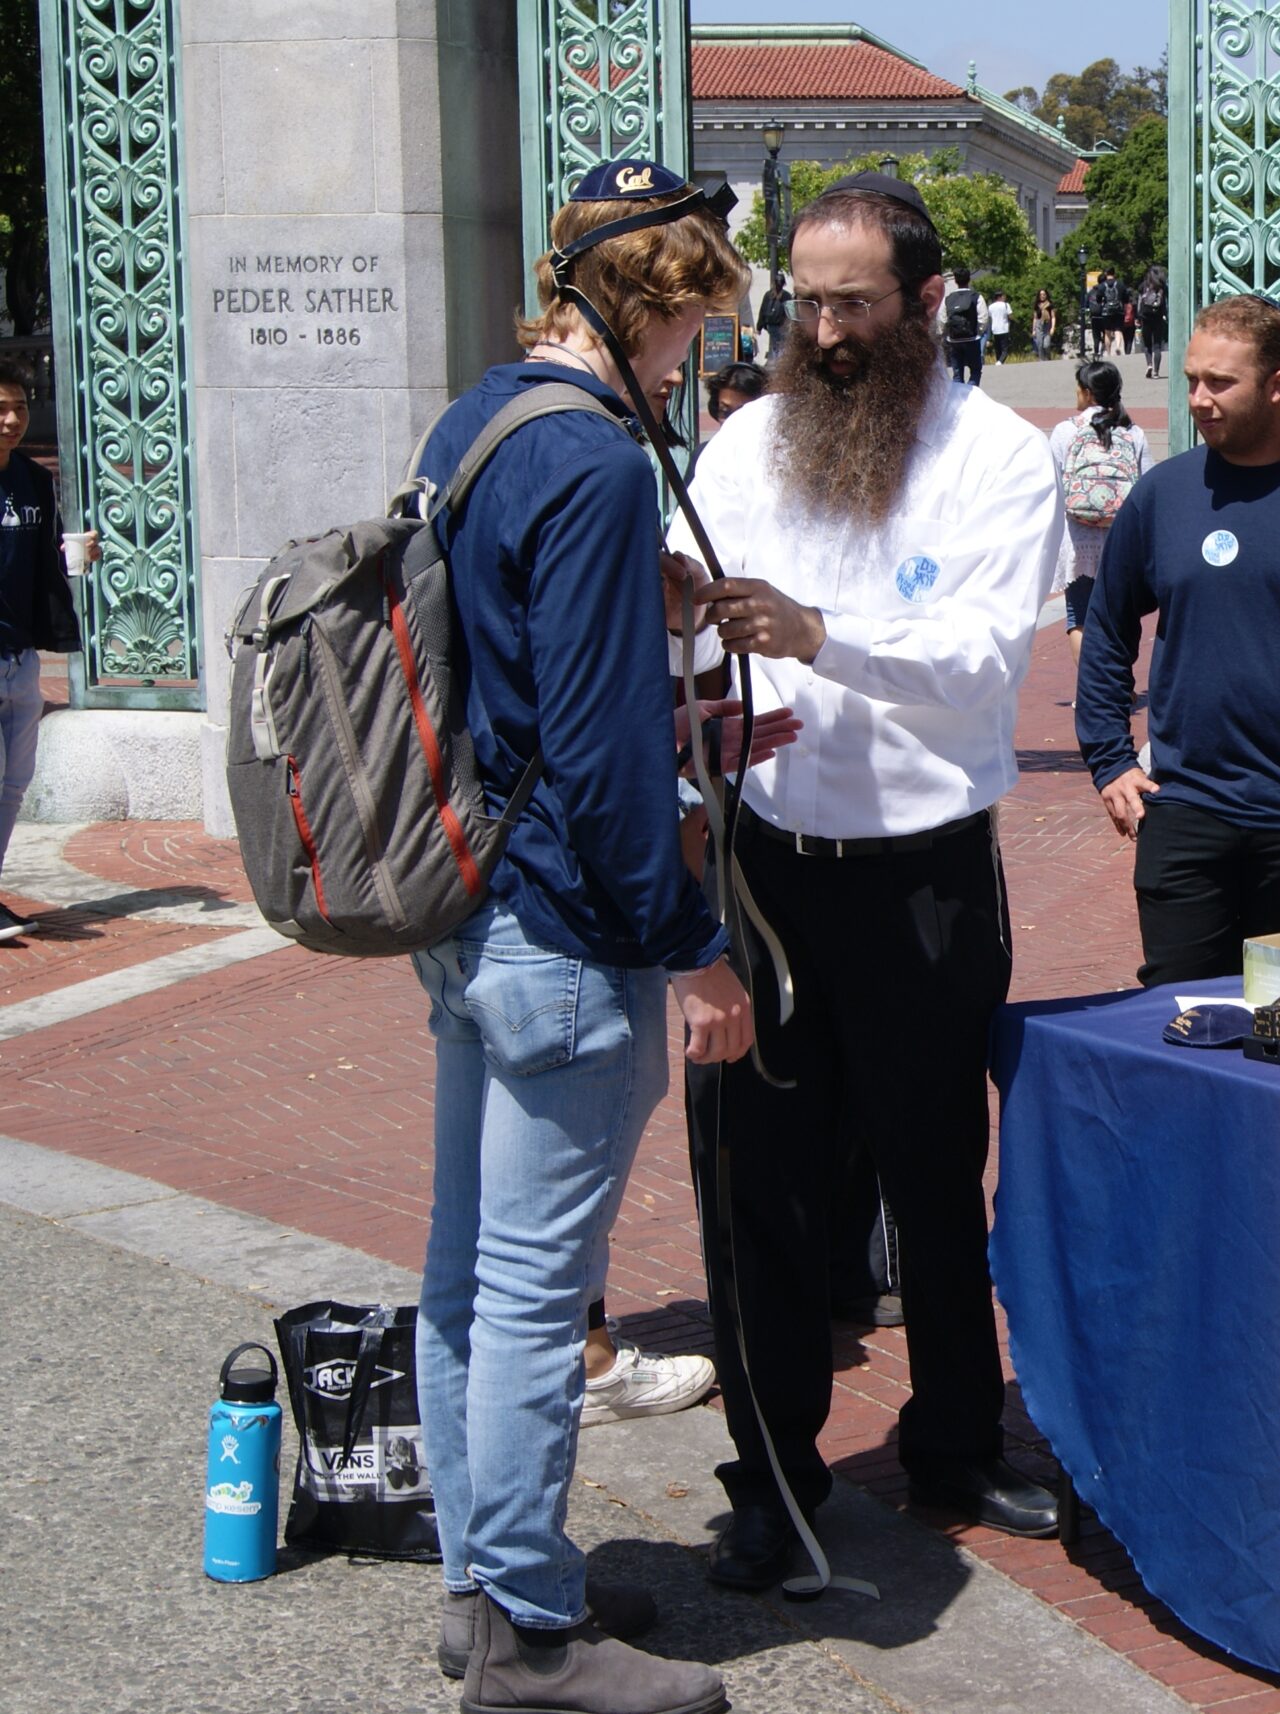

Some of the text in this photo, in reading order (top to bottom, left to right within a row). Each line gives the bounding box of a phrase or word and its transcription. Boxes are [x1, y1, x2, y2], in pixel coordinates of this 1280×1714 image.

[616, 167, 654, 193] Cal
[229, 255, 379, 273] IN MEMORY OF
[213, 287, 399, 313] PEDER SATHER
[250, 328, 288, 345] 1810
[317, 328, 361, 345] 1886
[321, 1450, 374, 1470] VANS
